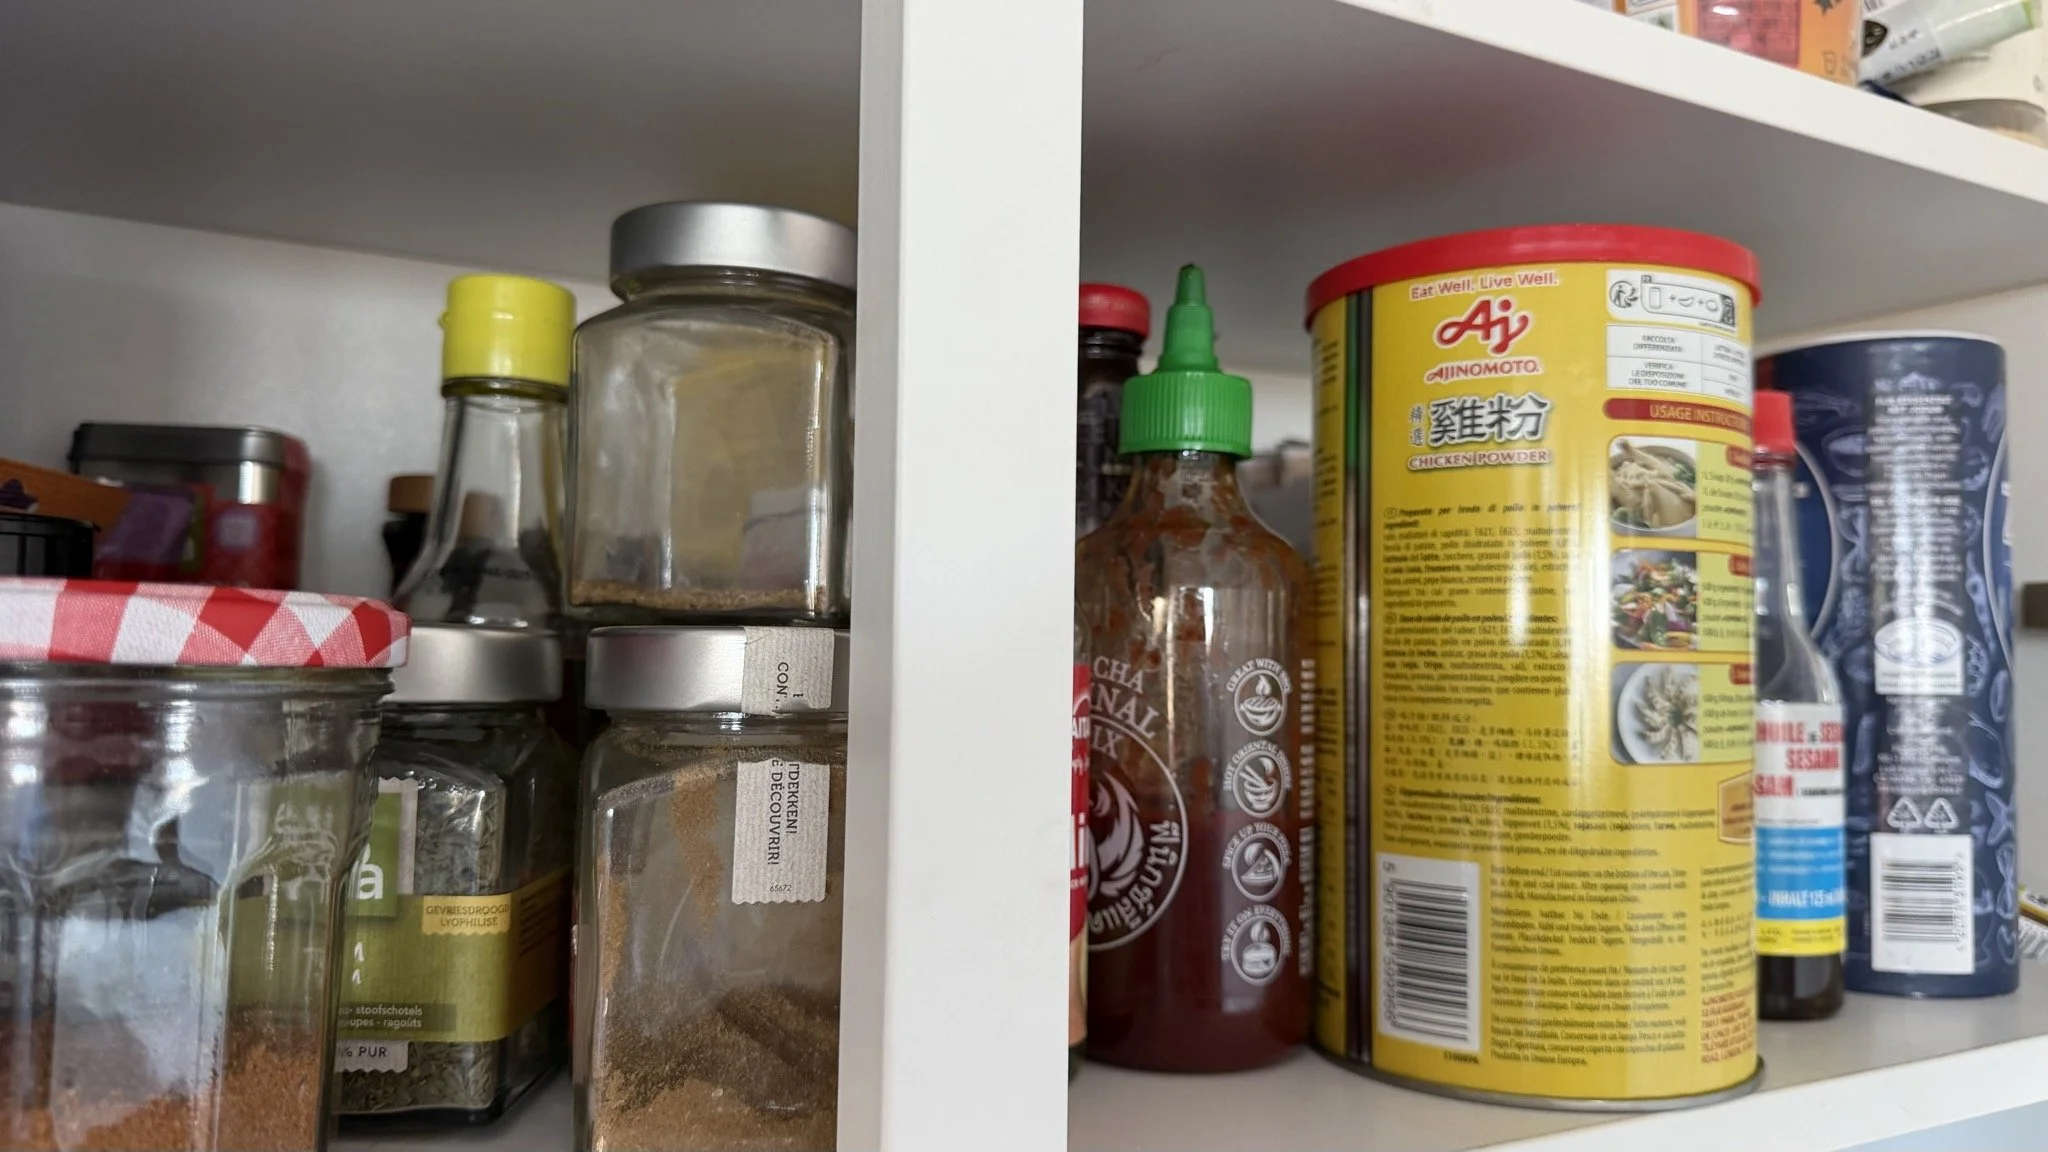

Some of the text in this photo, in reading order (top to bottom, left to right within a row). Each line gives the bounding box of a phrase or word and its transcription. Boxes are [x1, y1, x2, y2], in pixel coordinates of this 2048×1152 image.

[1411, 287, 1434, 299] Eat
[1480, 276, 1513, 289] Live
[1518, 272, 1558, 286] Well.
[1436, 299, 1529, 354] Aj
[1431, 394, 1549, 443] 雞粉
[1650, 404, 1692, 420] USAGE
[1409, 449, 1549, 469] CHICKEN POWDER
[1091, 656, 1144, 694] CHA
[1226, 659, 1255, 693] GREAT
[1255, 657, 1281, 674] WITH
[767, 771, 783, 865] DÉCOUVRIR!
[769, 884, 792, 892] 65672
[356, 1004, 423, 1016] stoofschotels
[383, 1017, 422, 1029] ragoûts
[359, 1046, 387, 1057] PUR
